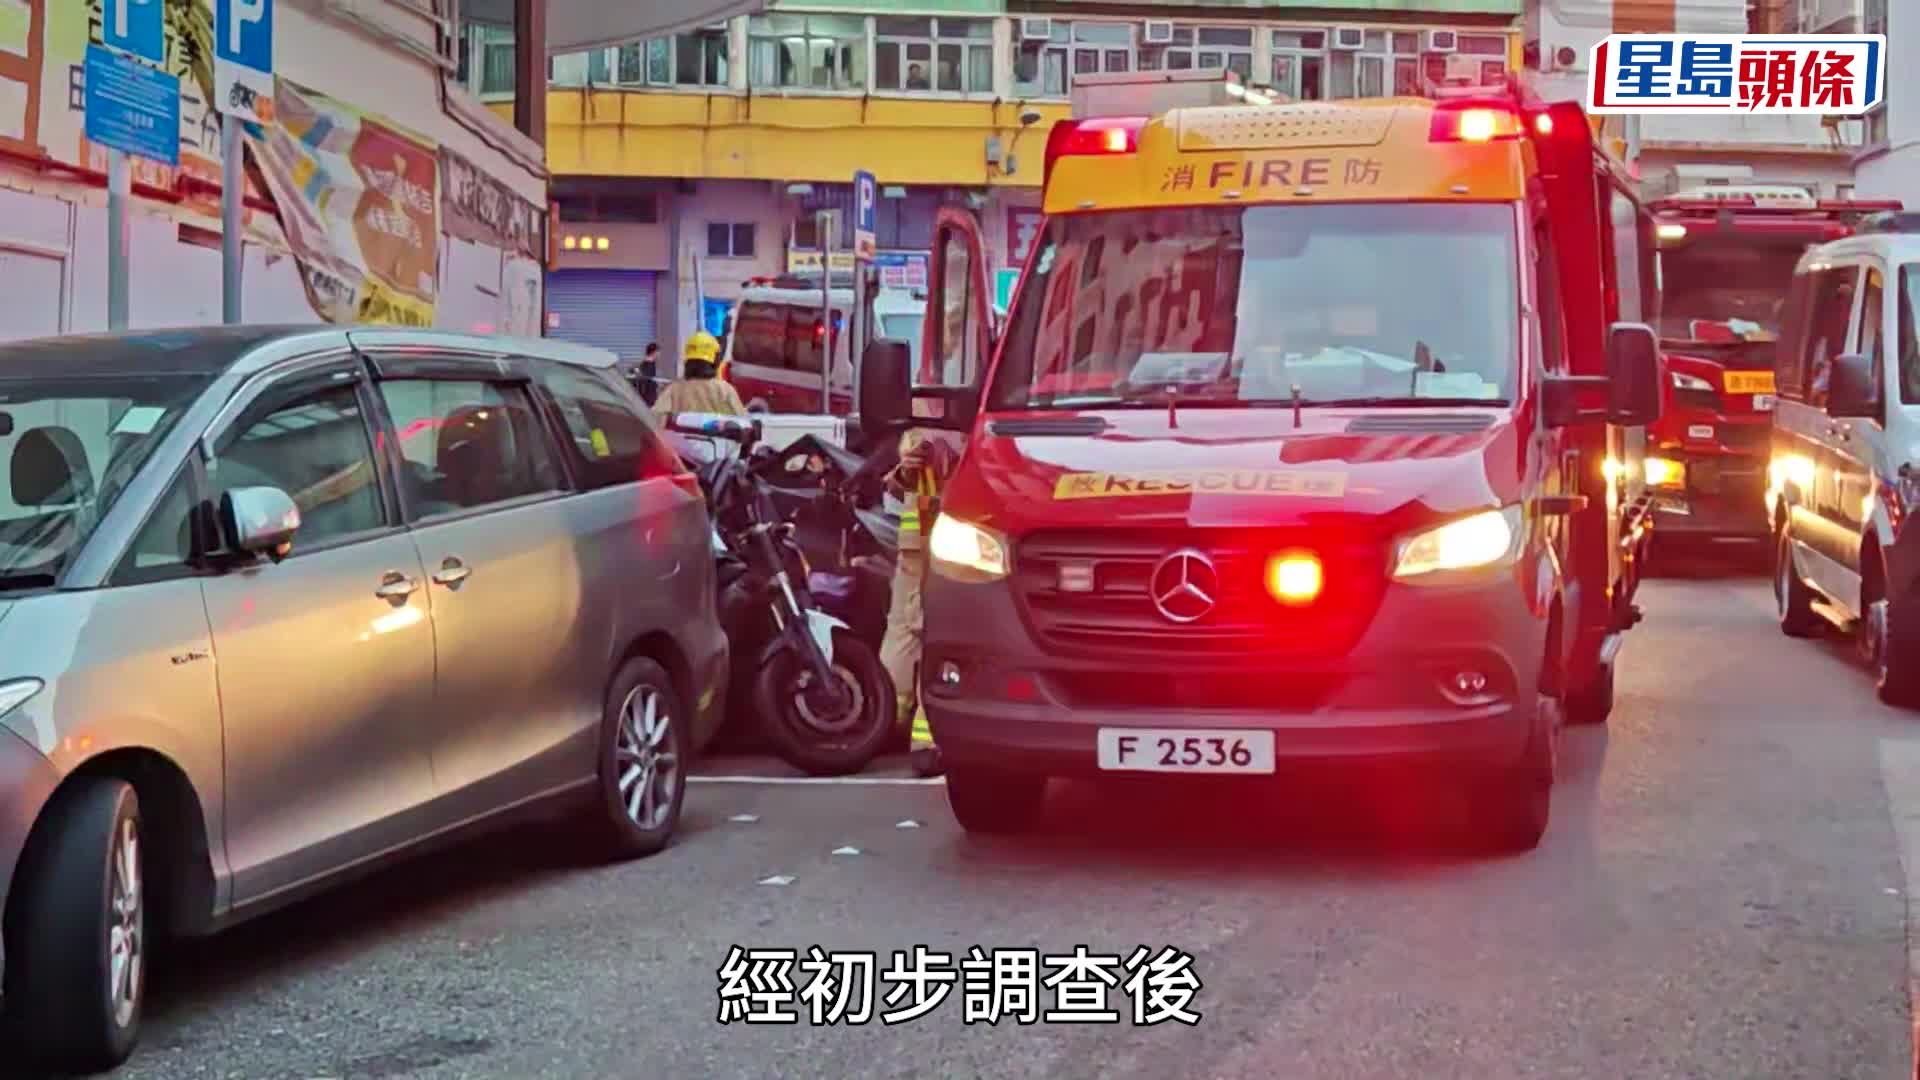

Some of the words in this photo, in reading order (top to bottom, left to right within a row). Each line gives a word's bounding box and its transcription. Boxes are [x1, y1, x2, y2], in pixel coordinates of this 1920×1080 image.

[1160, 162, 1196, 192] 消
[1209, 158, 1332, 188] FIRE
[1344, 157, 1383, 185] 防
[860, 177, 873, 226] P
[1118, 736, 1139, 764] F
[1157, 737, 1252, 766] 2536
